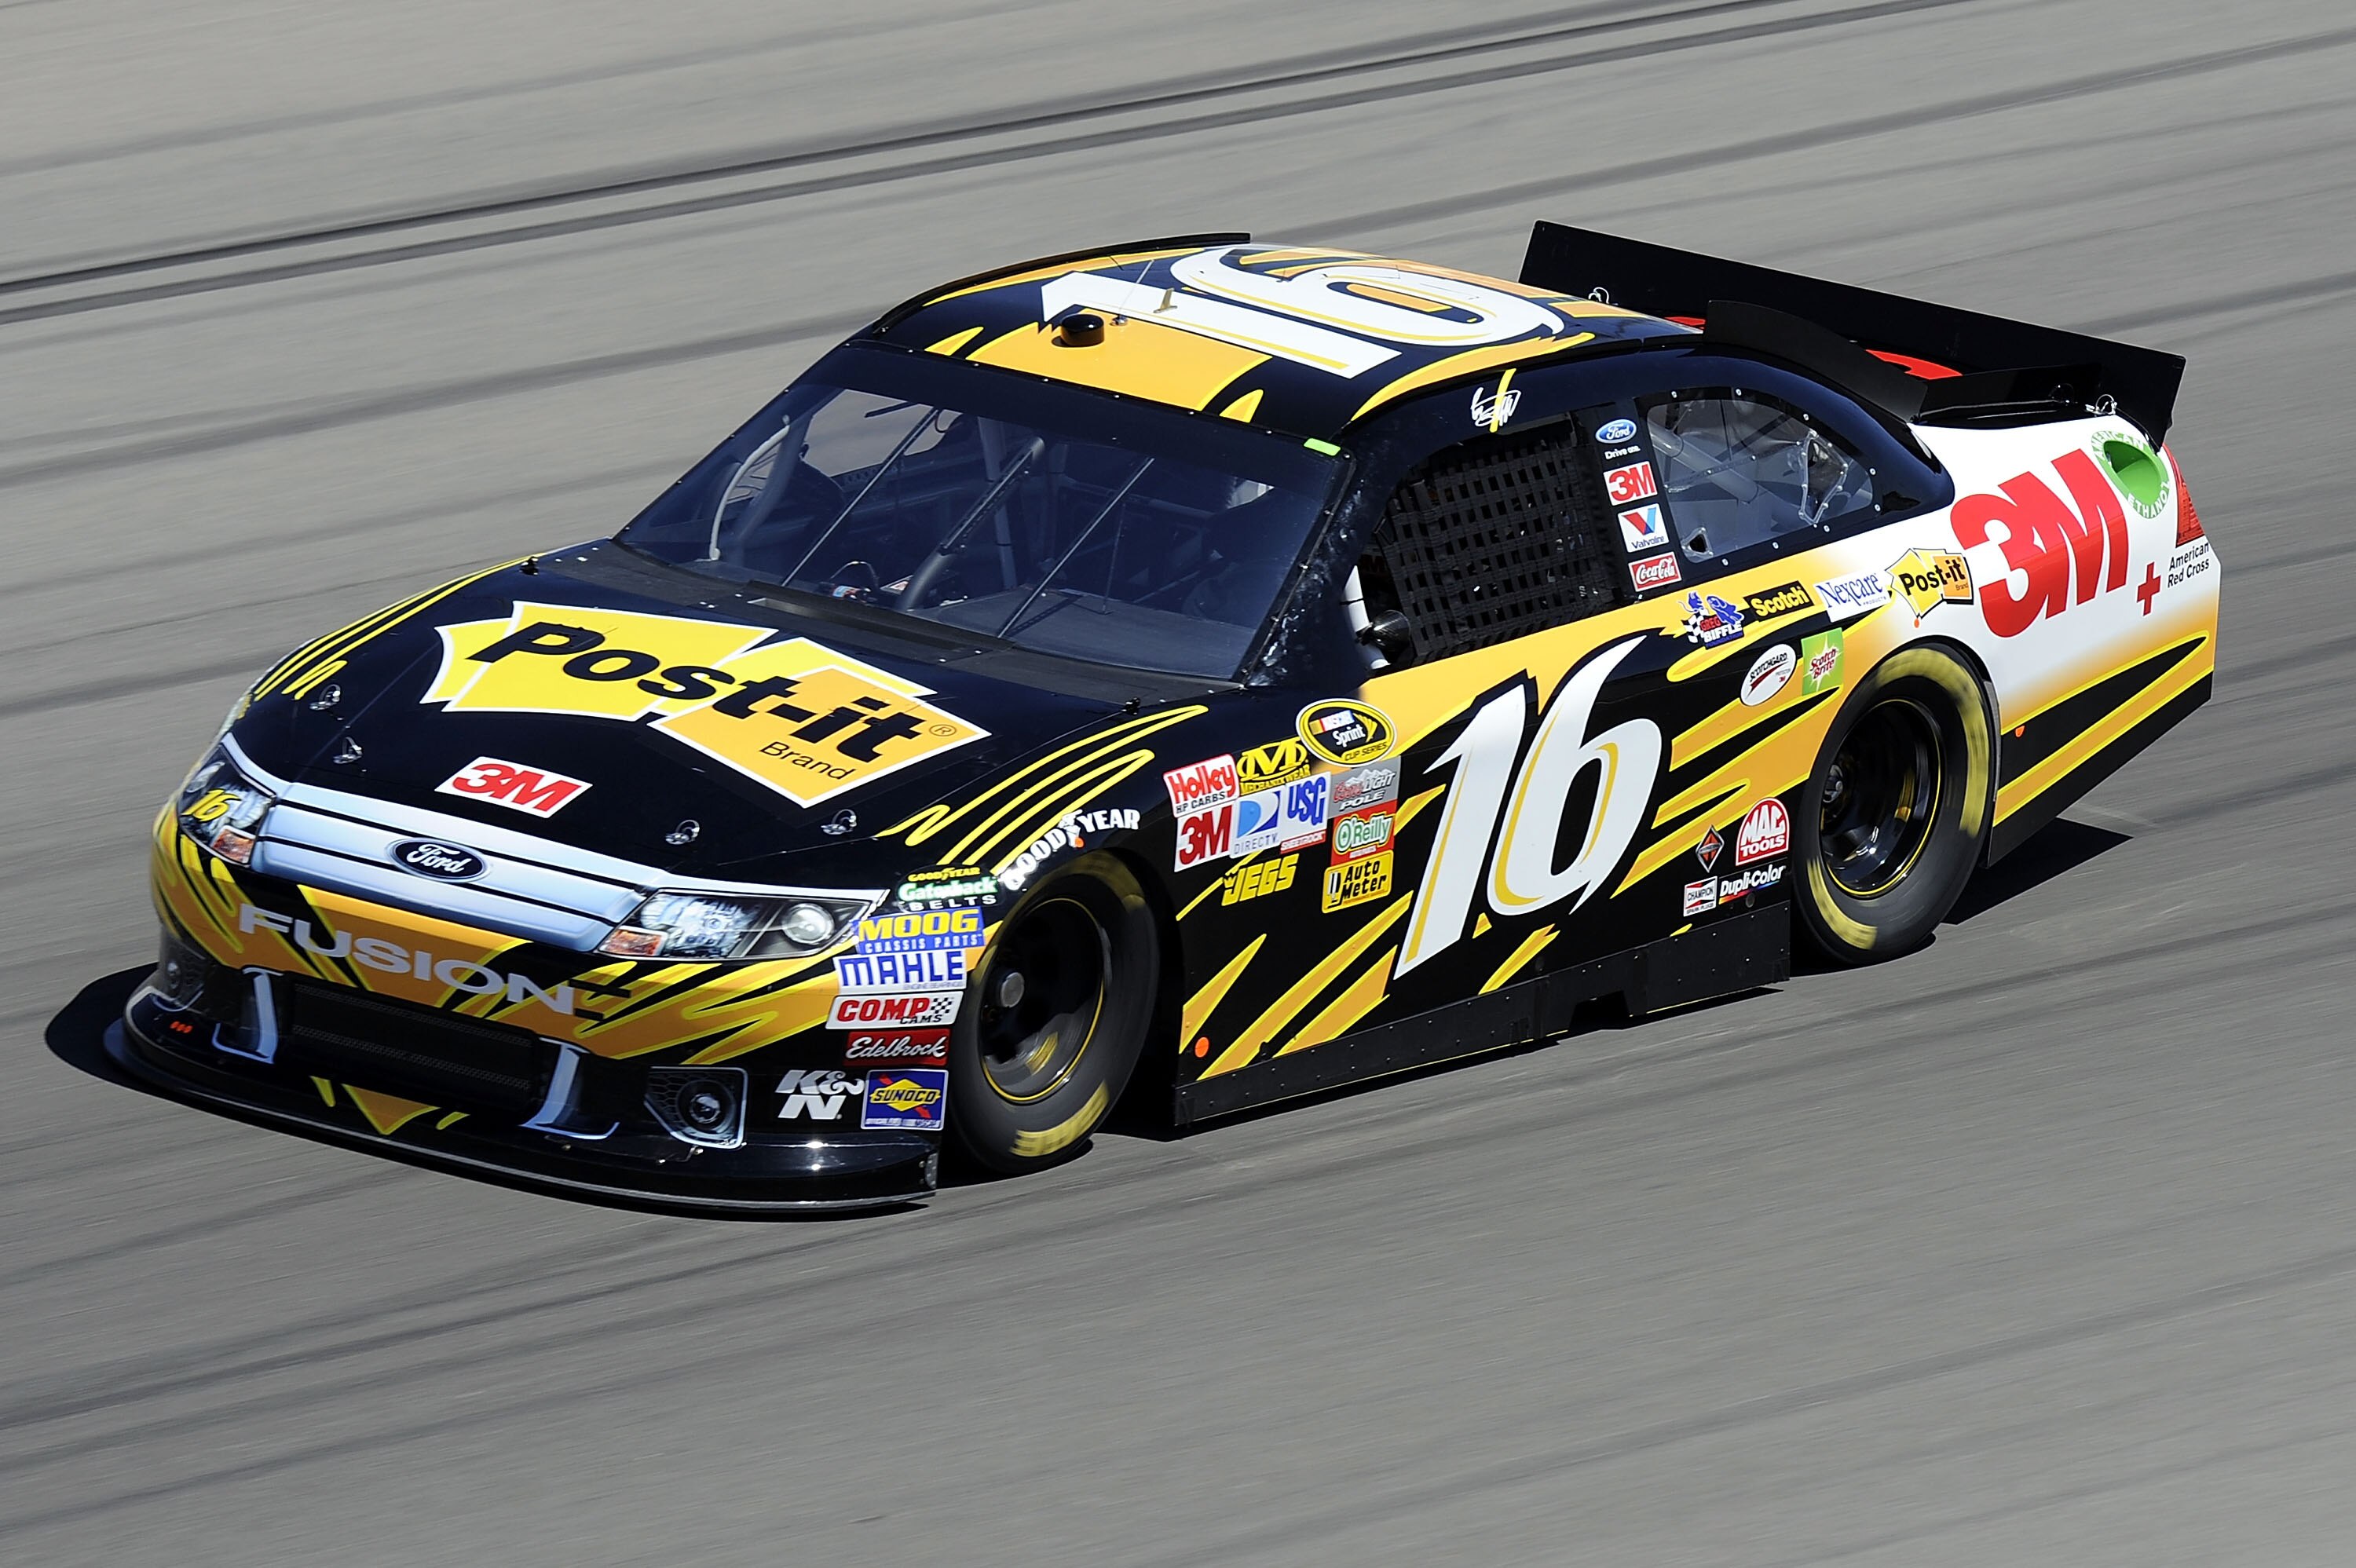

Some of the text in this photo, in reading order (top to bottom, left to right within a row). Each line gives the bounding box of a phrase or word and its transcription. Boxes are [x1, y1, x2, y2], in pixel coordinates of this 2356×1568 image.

[1041, 246, 1565, 379] 16
[1606, 423, 1630, 439] Ford
[1604, 448, 1627, 460] Drive
[2091, 430, 2145, 462] AMERICAN
[1608, 464, 1655, 501] 3M
[2127, 481, 2170, 519] ETHANOL
[1631, 535, 1665, 550] Valvoline
[1949, 448, 2129, 638] 3M
[2169, 542, 2209, 571] American
[1898, 559, 1966, 597] Post-it
[1955, 582, 1969, 591] Brand
[2168, 558, 2209, 588] Red Cross
[1751, 587, 1810, 617] Scotch
[1816, 573, 1883, 608] Nexcare
[1699, 615, 1722, 631] GREG
[1703, 620, 1743, 643] BIFFLE
[1749, 652, 1789, 682] SCOTCHGARD
[1813, 660, 1835, 680] Brite
[465, 620, 936, 763] Post-it
[1332, 724, 1366, 747] Sprint
[759, 740, 858, 782] Brand
[1344, 742, 1388, 762] CUP SERIES
[452, 762, 583, 813] 3M
[1168, 765, 1237, 804] Holley
[1286, 764, 1311, 783] WEAR
[1363, 773, 1396, 793] LIGHT
[180, 788, 240, 823] 16
[1176, 791, 1226, 813] HP CARBS
[1287, 777, 1326, 826] USG
[1339, 791, 1385, 812] POLE
[1394, 634, 1663, 981] 16
[1179, 805, 1233, 866] 3M
[1337, 816, 1392, 850] O'Reilly
[1740, 804, 1786, 846] MAC
[405, 841, 474, 875] Ford
[1740, 835, 1785, 857] TOOLS
[908, 867, 982, 883] GOODYEAR
[1220, 853, 1300, 906] JEGS
[1344, 861, 1381, 883] Auto
[1719, 864, 1784, 897] Dupli-Color
[898, 876, 999, 902] Gatorback
[1340, 874, 1387, 901] Meter
[1687, 886, 1714, 902] CHAMPION
[907, 894, 997, 912] BELTS
[858, 908, 981, 941] MOOG
[865, 934, 979, 954] CHASSIS PARTS
[238, 903, 575, 1016] FUSION
[839, 950, 963, 987] MAHLE
[836, 997, 930, 1022] COMP
[899, 1014, 943, 1025] CAMS
[845, 1036, 947, 1059] Edelbrock
[872, 1089, 937, 1103] SUNOCO
